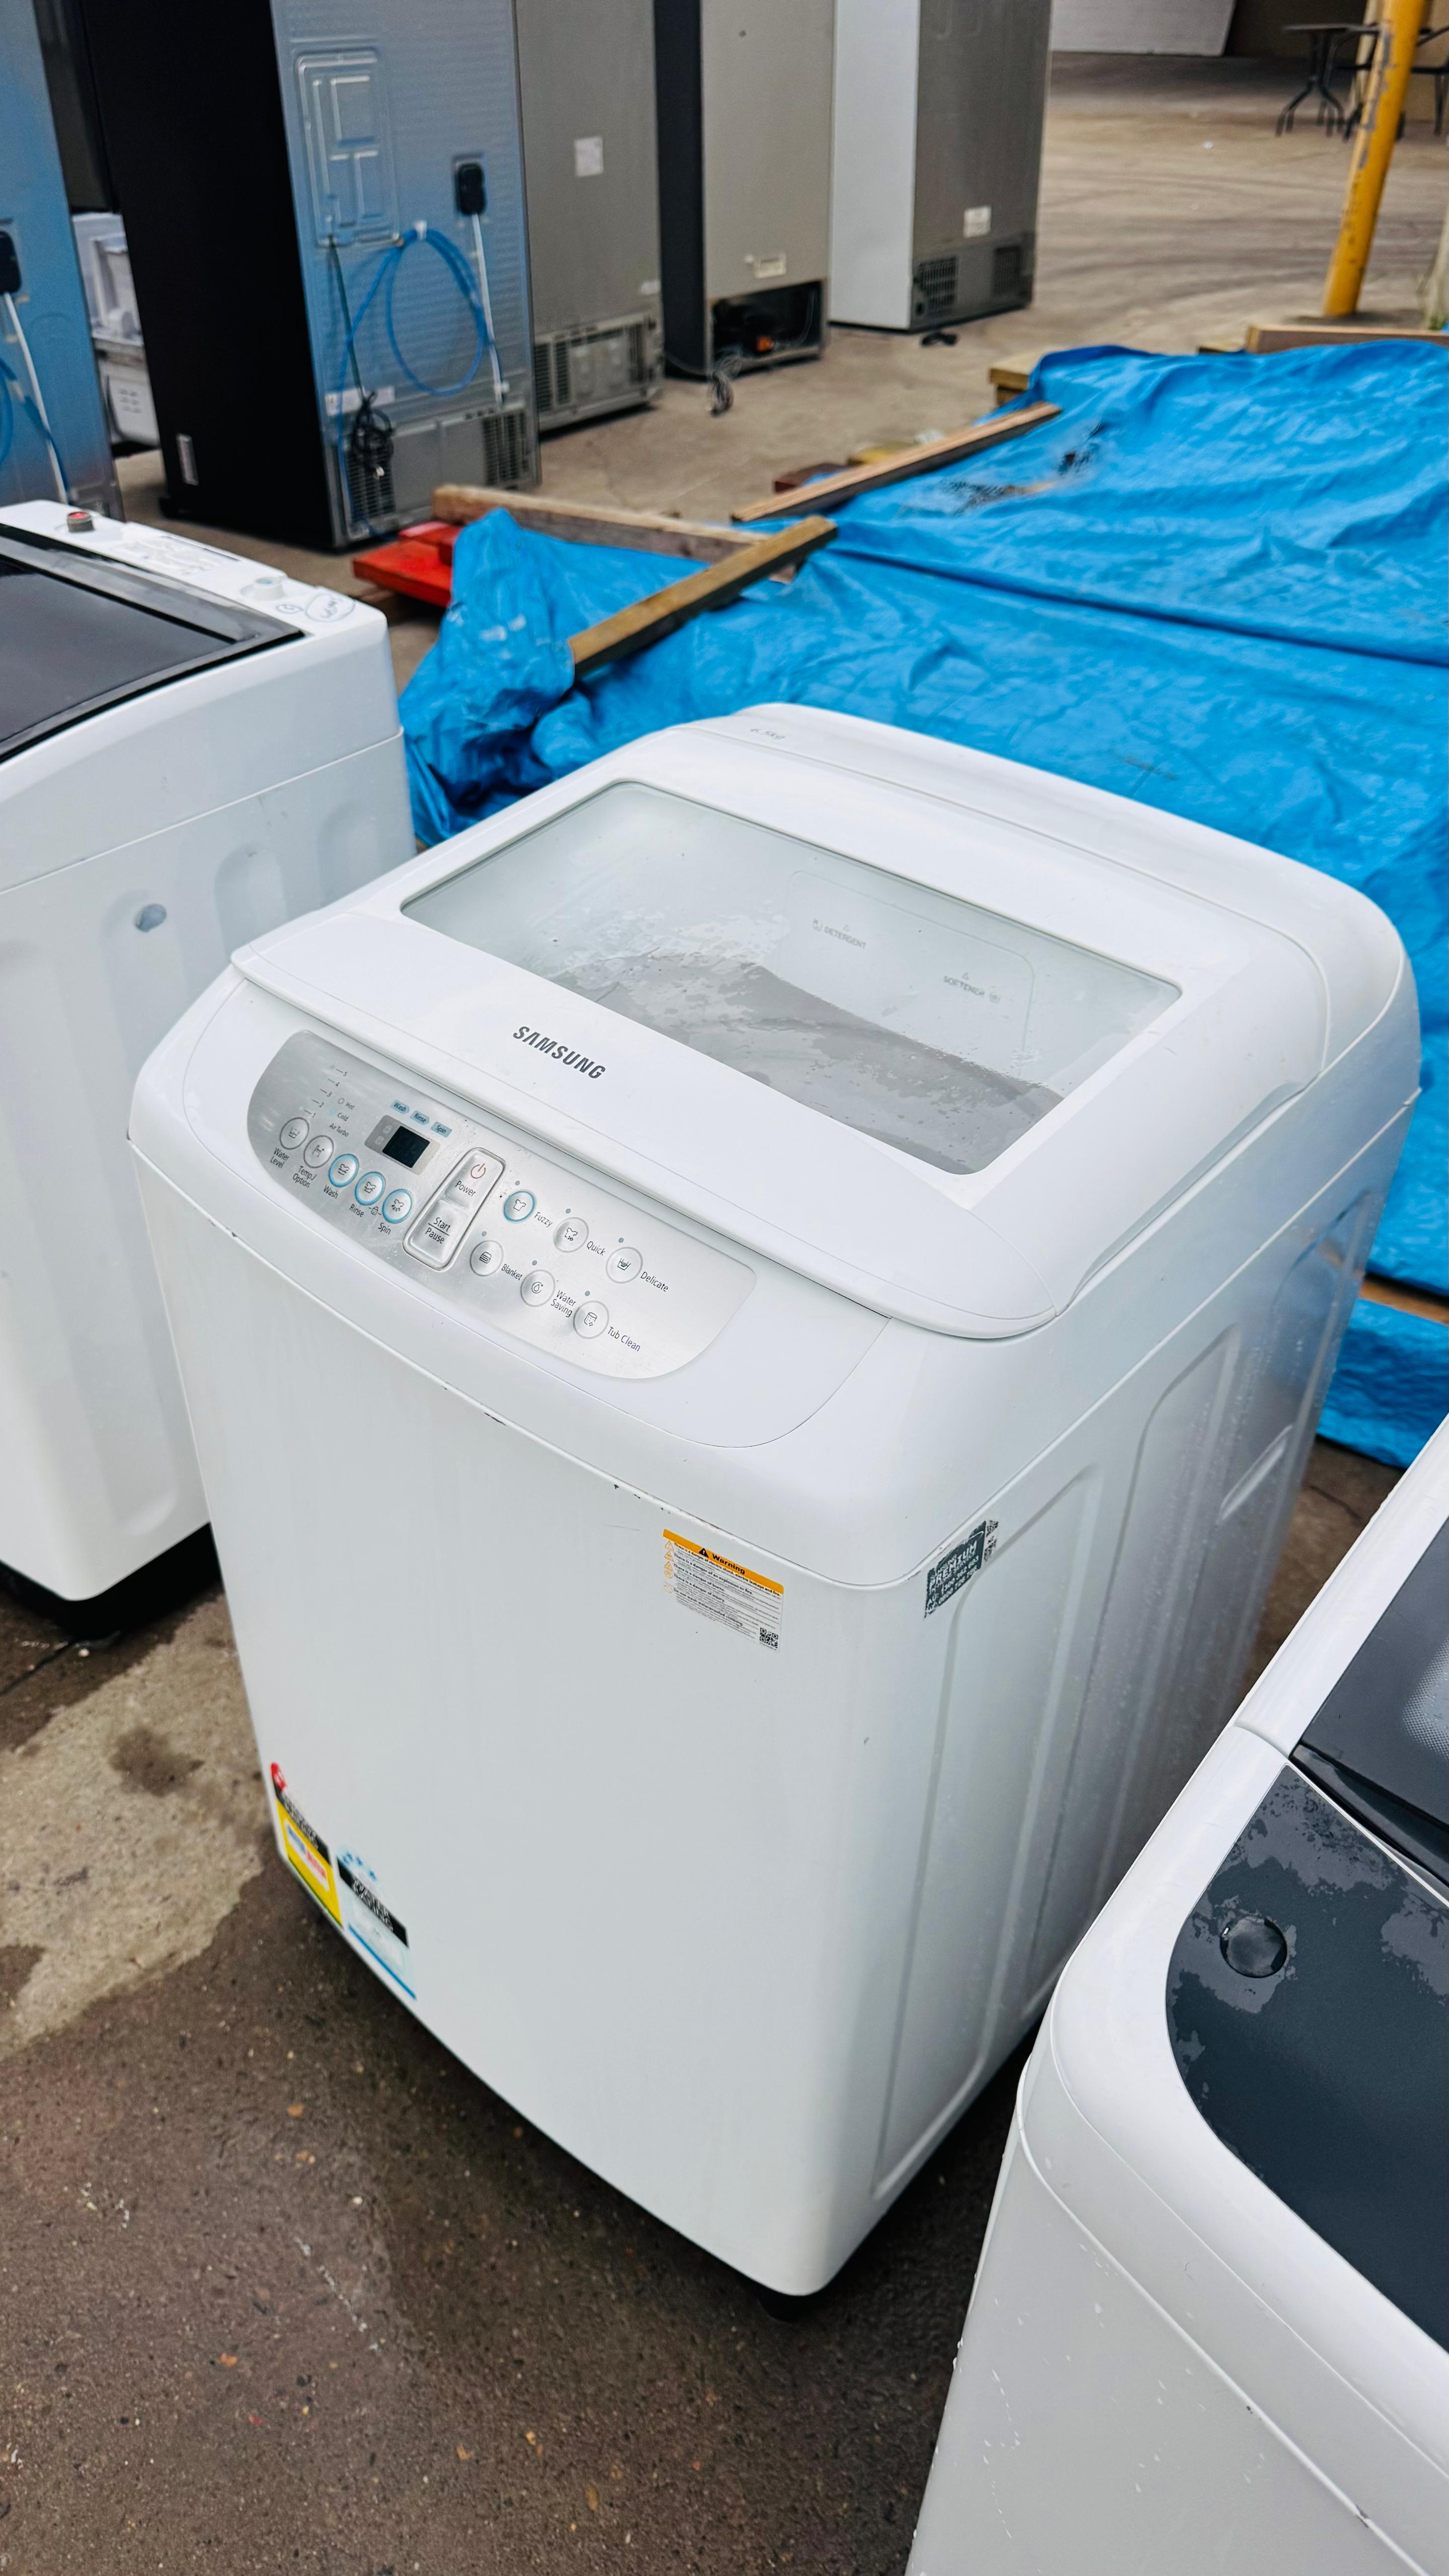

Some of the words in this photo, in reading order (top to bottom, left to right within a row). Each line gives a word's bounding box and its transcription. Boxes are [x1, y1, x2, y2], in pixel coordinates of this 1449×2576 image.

[513, 1026, 606, 1079] SAMSUNG
[394, 1102, 407, 1112] Wash
[338, 1112, 349, 1121] Cold
[414, 1113, 426, 1123] Rinse
[436, 1125, 446, 1134] Spin
[270, 1156, 285, 1168] Level
[274, 1148, 289, 1161] Water
[293, 1173, 310, 1188] Option
[324, 1184, 339, 1199] Wash
[455, 1180, 476, 1197] Power
[349, 1203, 364, 1218] Rinse
[433, 1217, 451, 1232] Start
[534, 1212, 553, 1228] Fuzzy
[378, 1222, 391, 1235] Spin
[425, 1227, 445, 1244] Pause
[586, 1241, 606, 1256] Quick
[501, 1263, 523, 1281] Blanket
[640, 1271, 669, 1292] Delicate
[556, 1290, 577, 1307] Water
[550, 1299, 573, 1318] Saving
[608, 1326, 620, 1339] Tub
[620, 1334, 640, 1352] Clean
[712, 1553, 745, 1575] Warning
[929, 1540, 977, 1590] PREMIUM
